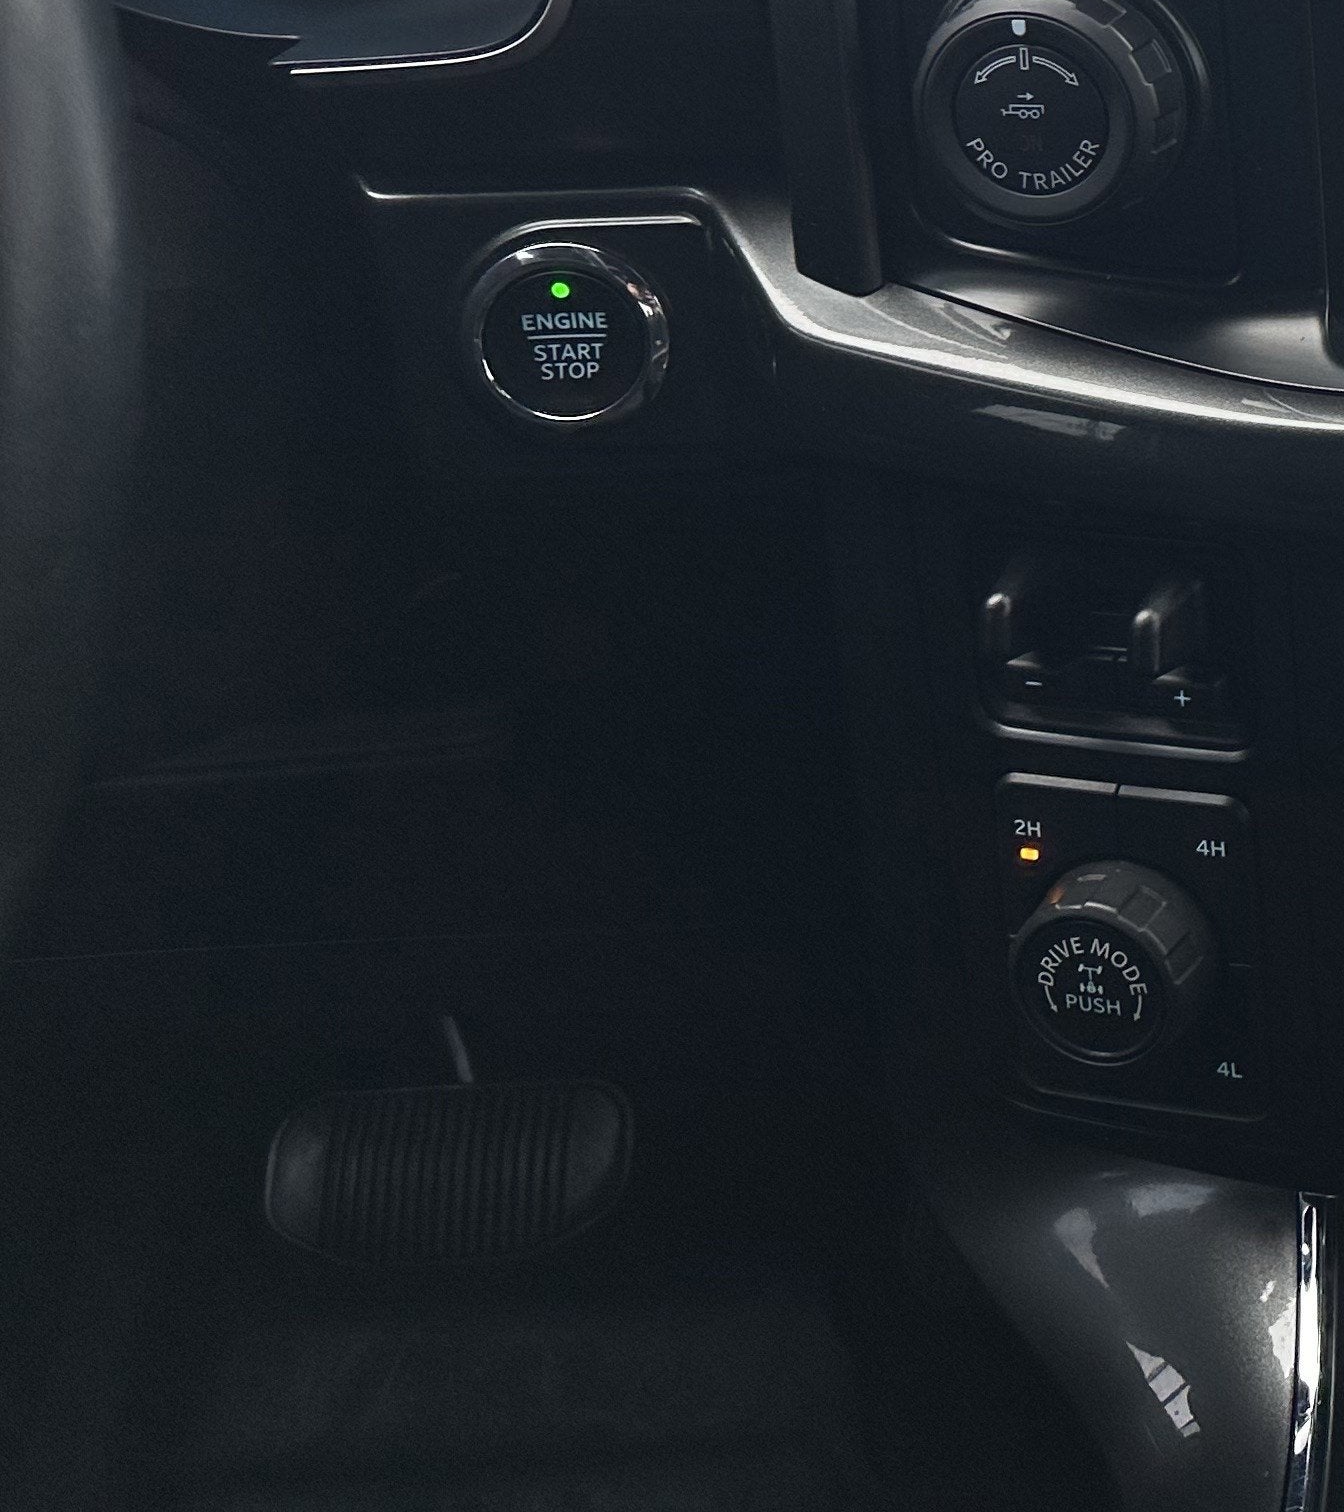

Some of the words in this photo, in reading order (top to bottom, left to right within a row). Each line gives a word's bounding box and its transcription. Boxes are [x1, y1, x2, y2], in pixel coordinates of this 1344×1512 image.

[967, 138, 1007, 178] PRO
[1018, 139, 1100, 190] TRAILER
[522, 313, 607, 330] ENGINE
[534, 343, 603, 361] START
[541, 362, 599, 380] STOP
[1015, 819, 1041, 837] 2H
[1196, 840, 1225, 857] 4H
[1037, 936, 1085, 988] DRIVE
[1090, 938, 1148, 995] MODE
[1065, 994, 1121, 1016] PUSH
[1217, 1062, 1242, 1078] 4L
